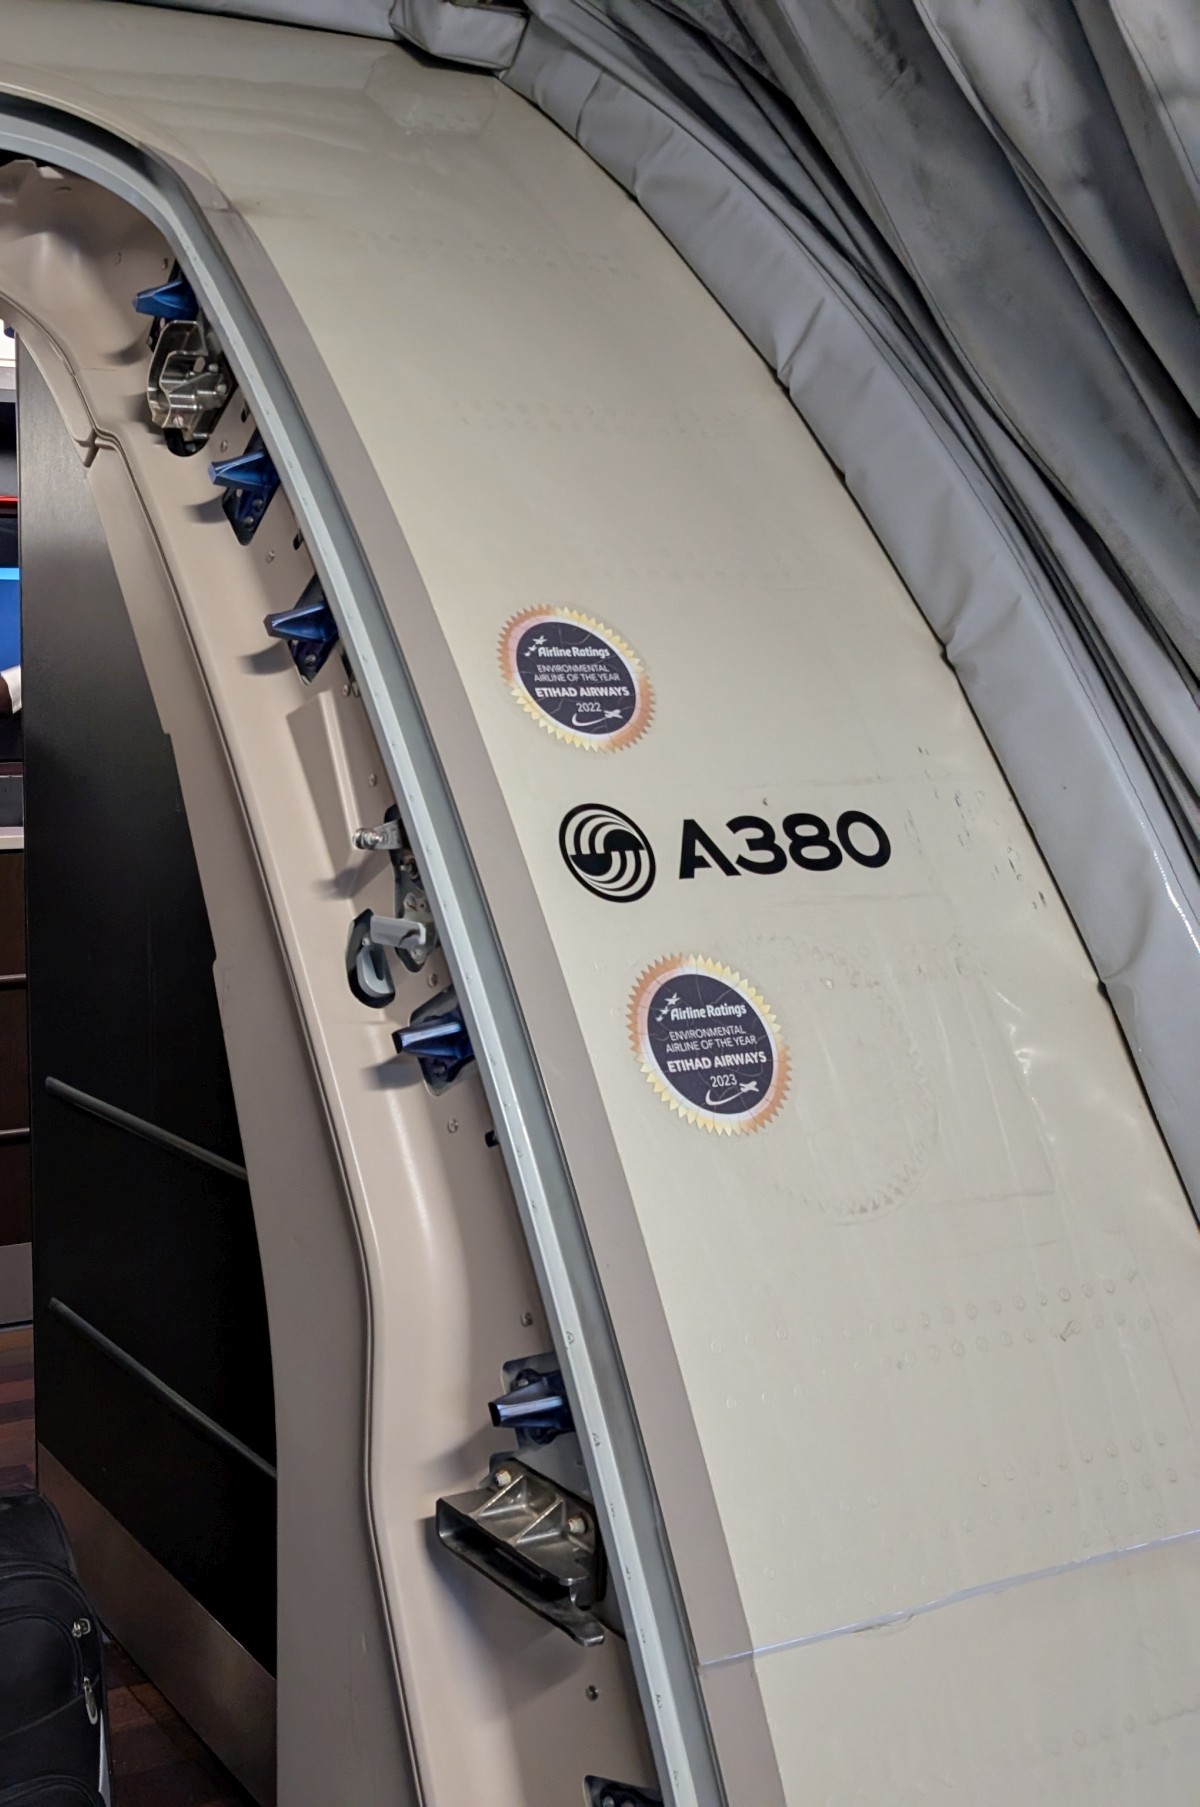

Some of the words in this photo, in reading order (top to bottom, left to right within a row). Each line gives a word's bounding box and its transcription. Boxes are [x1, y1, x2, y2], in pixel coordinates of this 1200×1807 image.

[538, 646, 571, 658] Airline
[572, 646, 610, 659] Ratings
[536, 664, 610, 673] ENVIRONMENTAL
[534, 673, 566, 682] AIRLINE
[567, 673, 580, 682] OF
[580, 673, 597, 682] THE
[597, 673, 620, 682] YEAR
[534, 687, 578, 698] ETIHAD
[579, 686, 630, 697] AIRWAYS
[576, 702, 602, 712] 2022
[679, 810, 892, 880] A380
[670, 1006, 706, 1021] Airline
[707, 1003, 747, 1018] Ratings
[669, 1025, 746, 1041] ENVIRONMENTAL
[666, 1040, 700, 1053] AIRLINE
[700, 1039, 714, 1050] OF
[715, 1038, 733, 1049] THE
[733, 1035, 758, 1047] YEAR
[666, 1057, 712, 1073] ETIHAD
[714, 1051, 767, 1068] AIRWAYS
[710, 1073, 737, 1088] 2023
